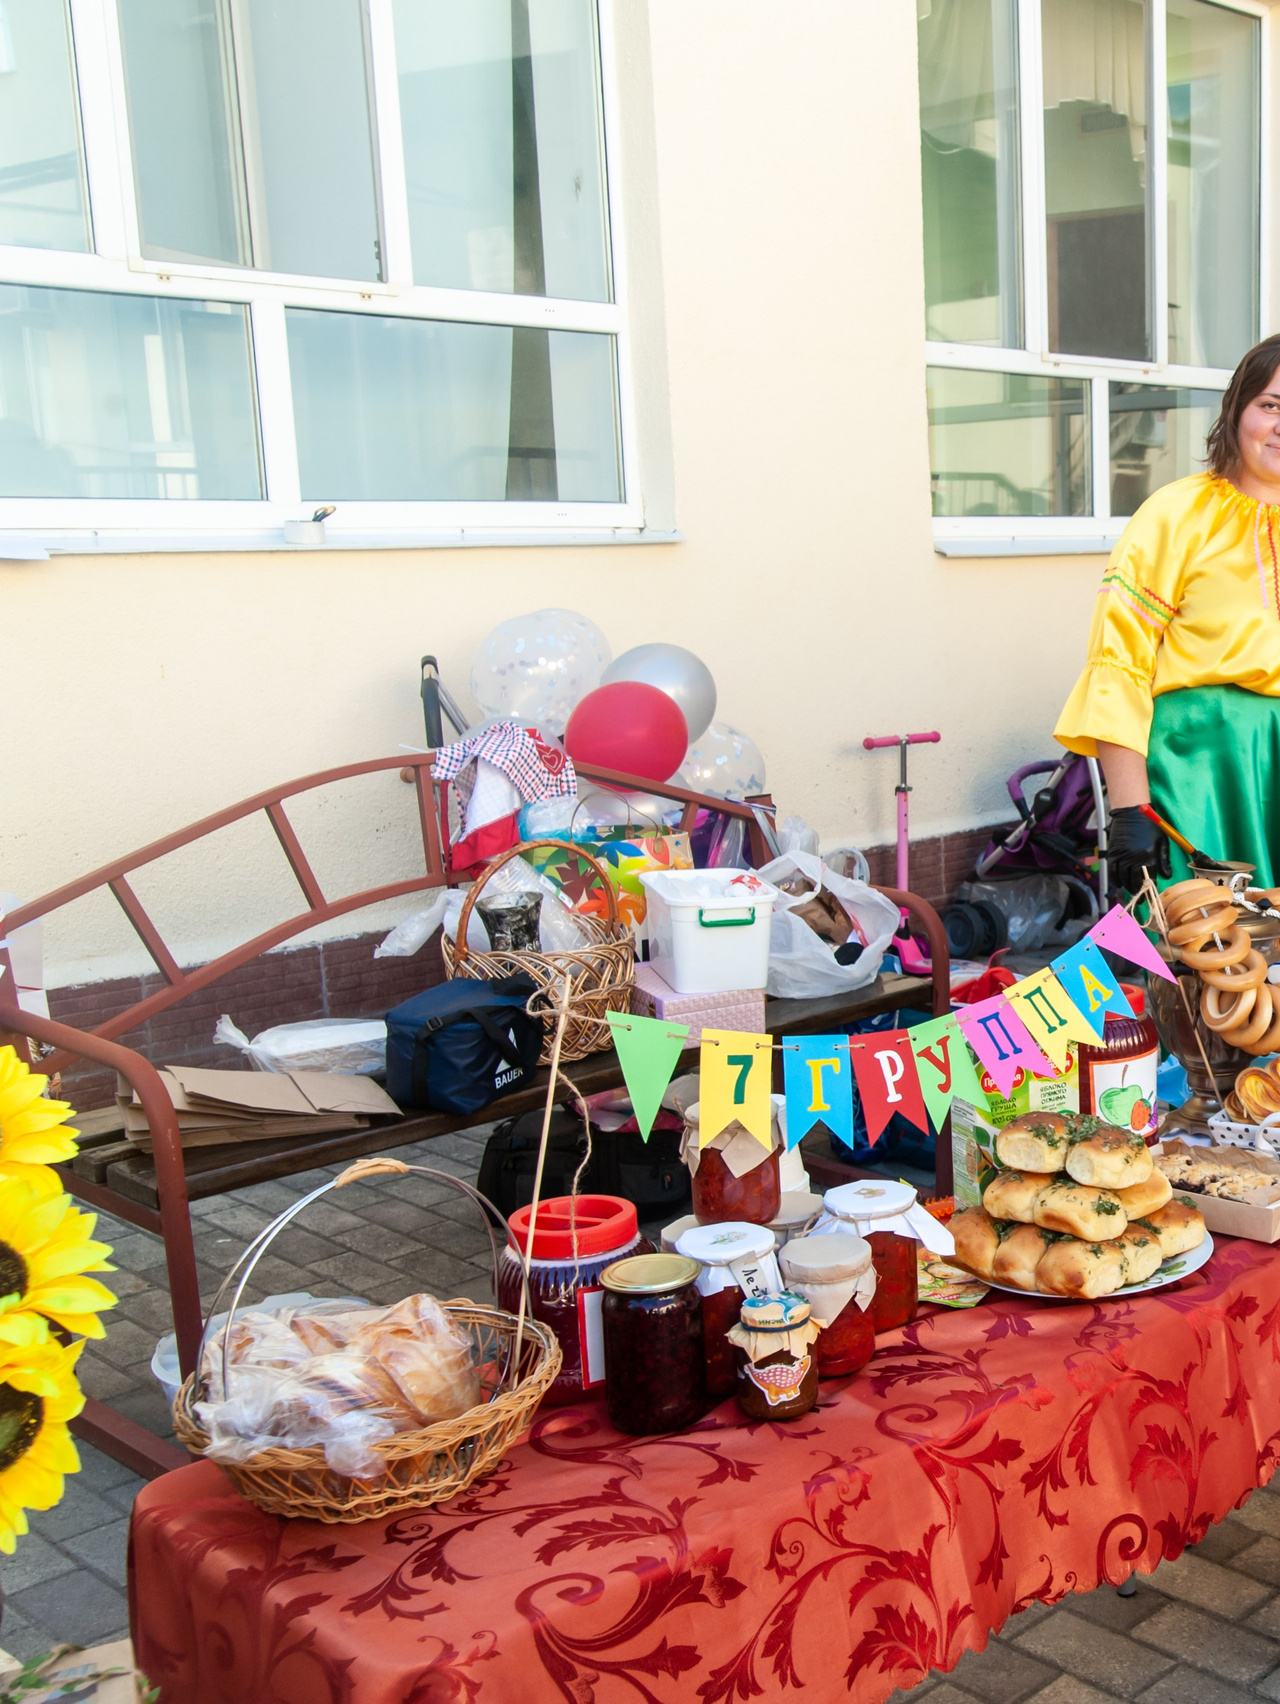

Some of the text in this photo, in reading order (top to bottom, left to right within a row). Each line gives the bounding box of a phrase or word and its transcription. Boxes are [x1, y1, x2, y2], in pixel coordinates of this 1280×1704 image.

[727, 964, 1113, 1112] 7 ГРУППА
[494, 1067, 524, 1089] BAUER
[990, 1103, 1017, 1113] ГРУША
